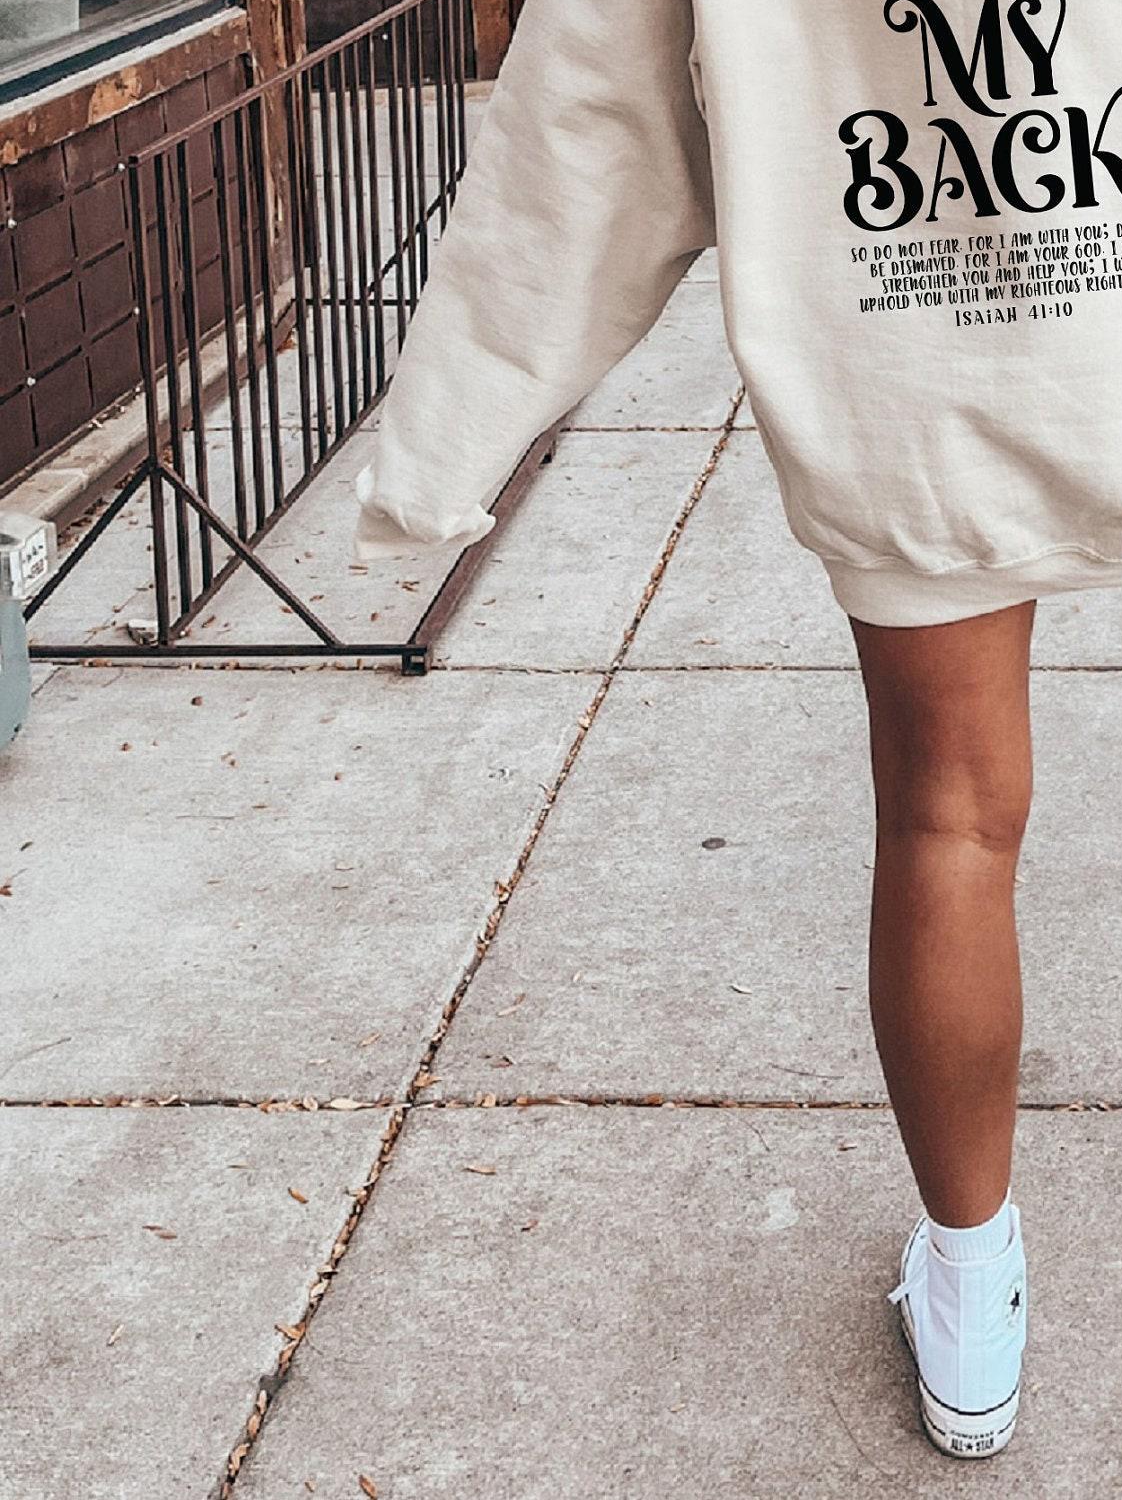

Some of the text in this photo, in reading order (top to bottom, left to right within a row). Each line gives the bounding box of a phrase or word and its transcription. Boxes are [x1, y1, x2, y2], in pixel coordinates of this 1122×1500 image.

[851, 247, 867, 262] SO
[874, 244, 892, 260] DO
[898, 241, 924, 258] NOT
[968, 234, 994, 252] FOR
[999, 233, 1005, 249] I
[1011, 232, 1034, 247] AM
[1038, 228, 1069, 244] WITH
[1074, 223, 1109, 242] YOU;
[870, 261, 886, 278] BE
[965, 252, 990, 269] FOR
[995, 251, 1002, 267] I
[1008, 249, 1030, 264] AM
[1034, 245, 1069, 262] YOUR
[1110, 240, 1118, 256] I
[859, 294, 910, 313] UPHOLD
[915, 291, 943, 308] YOU
[948, 287, 979, 304] WITH
[985, 285, 1006, 302] MY
[1011, 277, 1081, 299] RIGHTEOUS
[1085, 274, 1122, 292] RIGHT
[882, 273, 958, 294] STRENGTHEN
[962, 270, 989, 286] YOU
[995, 267, 1021, 282] AND
[1027, 263, 1055, 280] HELP
[1061, 258, 1095, 277] YOU;
[1101, 258, 1108, 273] I
[1028, 301, 1073, 320] 41:10
[975, 1437, 994, 1451] STAR
